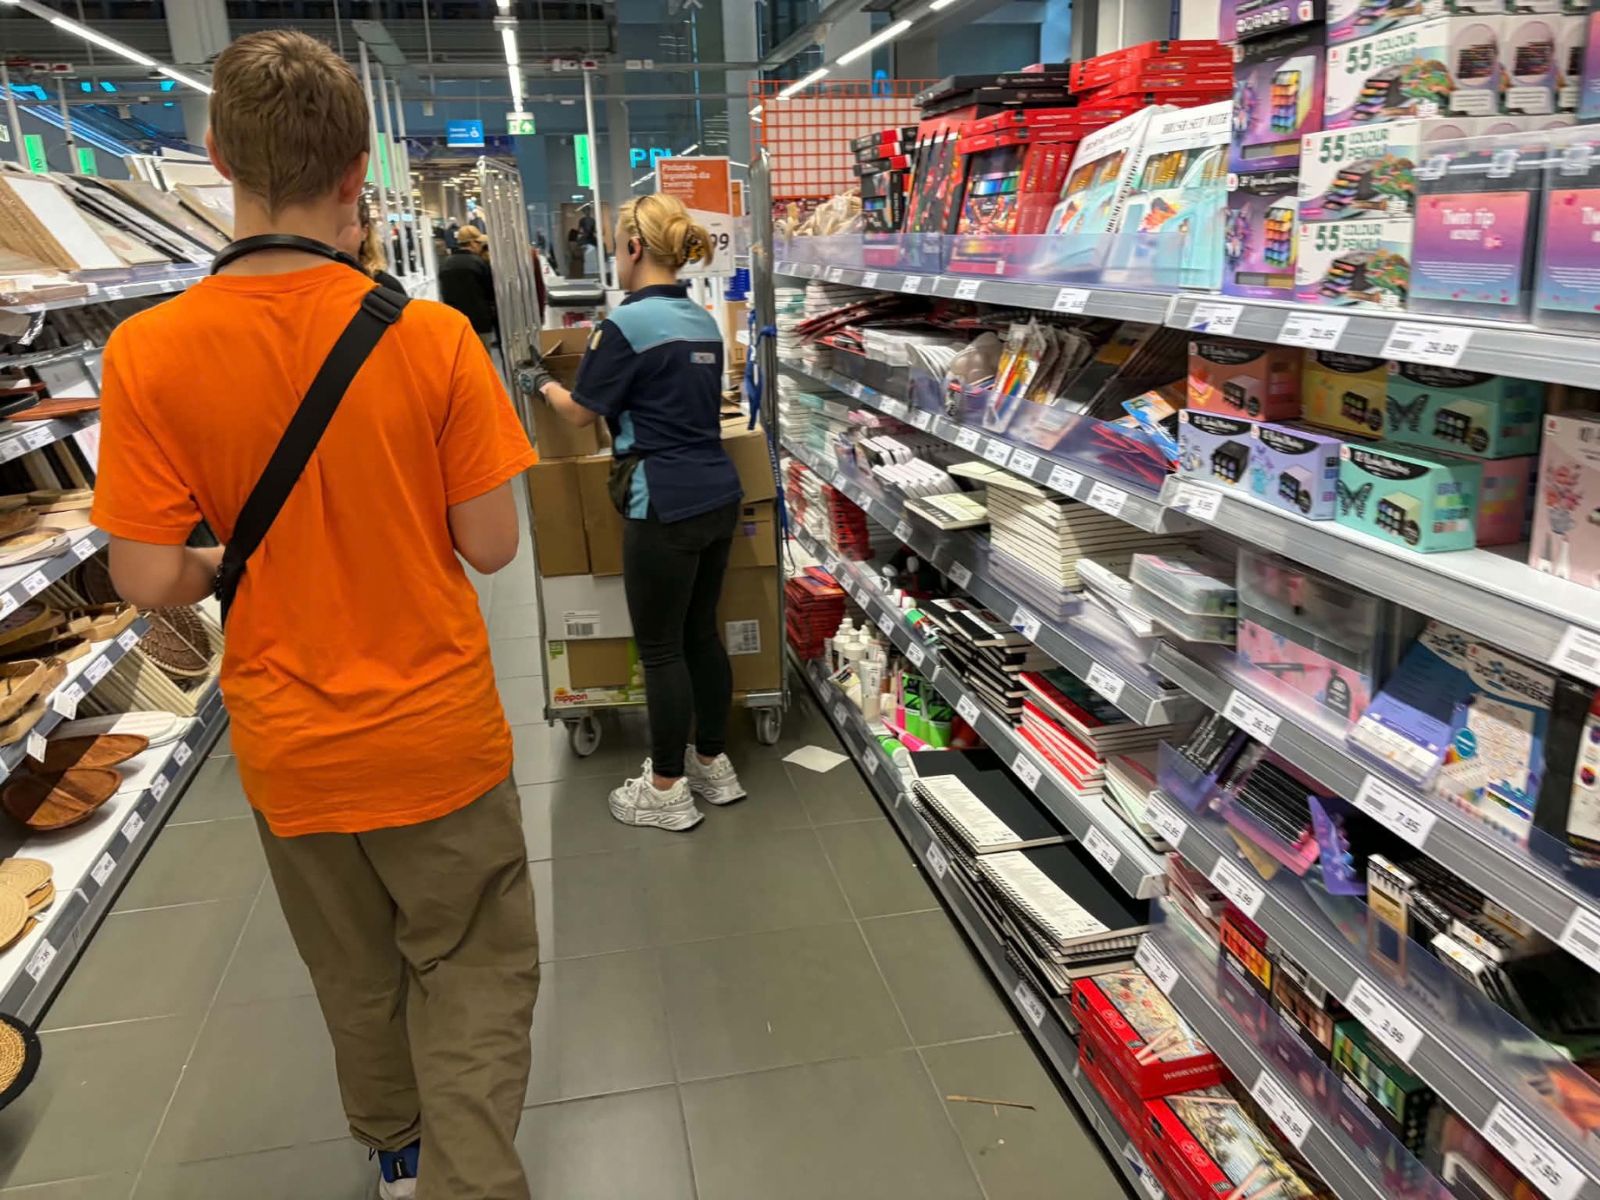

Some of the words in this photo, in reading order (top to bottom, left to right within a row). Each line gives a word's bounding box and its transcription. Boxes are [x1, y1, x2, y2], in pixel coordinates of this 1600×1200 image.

[1346, 43, 1373, 74] 55
[1320, 136, 1346, 163] 55
[1315, 225, 1340, 251] 55
[554, 692, 588, 704] nippon
[1395, 811, 1422, 833] 7.95
[1530, 1152, 1563, 1186] 7.95
